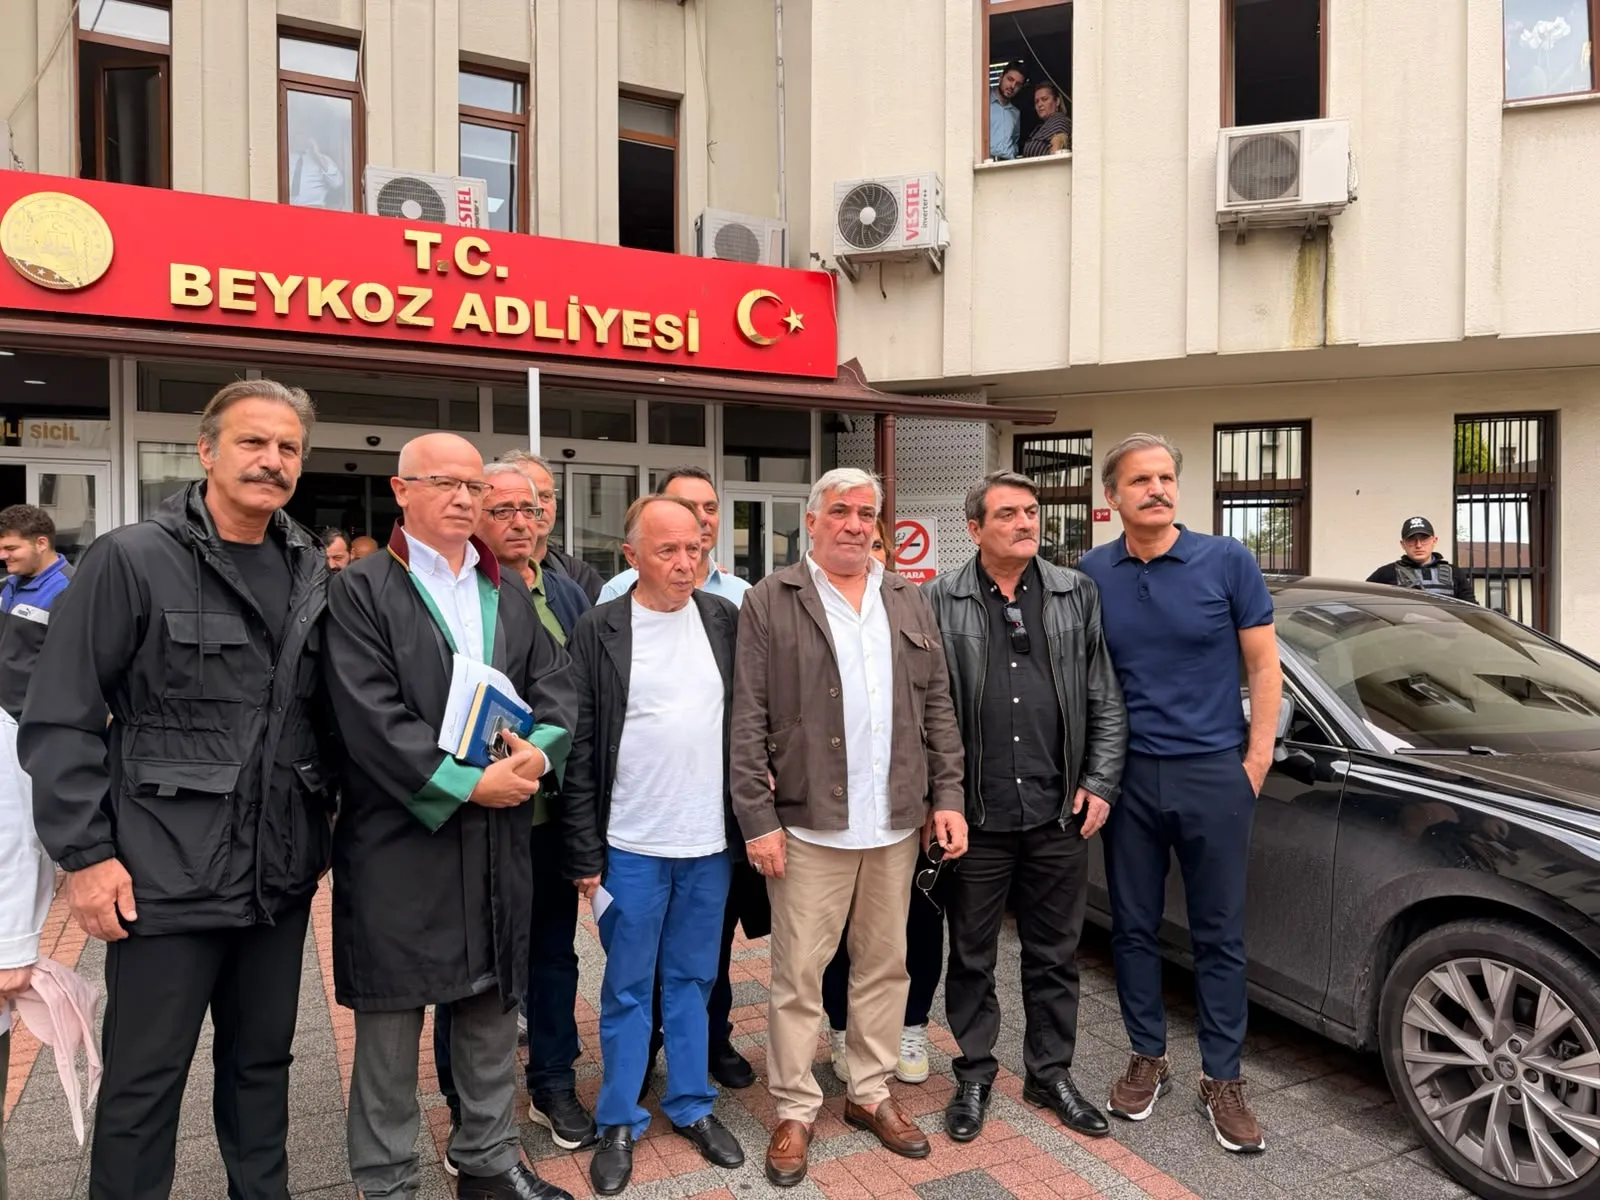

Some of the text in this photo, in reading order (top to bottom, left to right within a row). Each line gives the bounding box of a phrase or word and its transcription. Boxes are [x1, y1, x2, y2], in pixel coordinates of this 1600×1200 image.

[905, 178, 920, 241] VESTEL
[404, 229, 509, 279] T.C.
[169, 262, 700, 354] BEYKOZ ADLİYESİ
[30, 422, 80, 441] SİCİL
